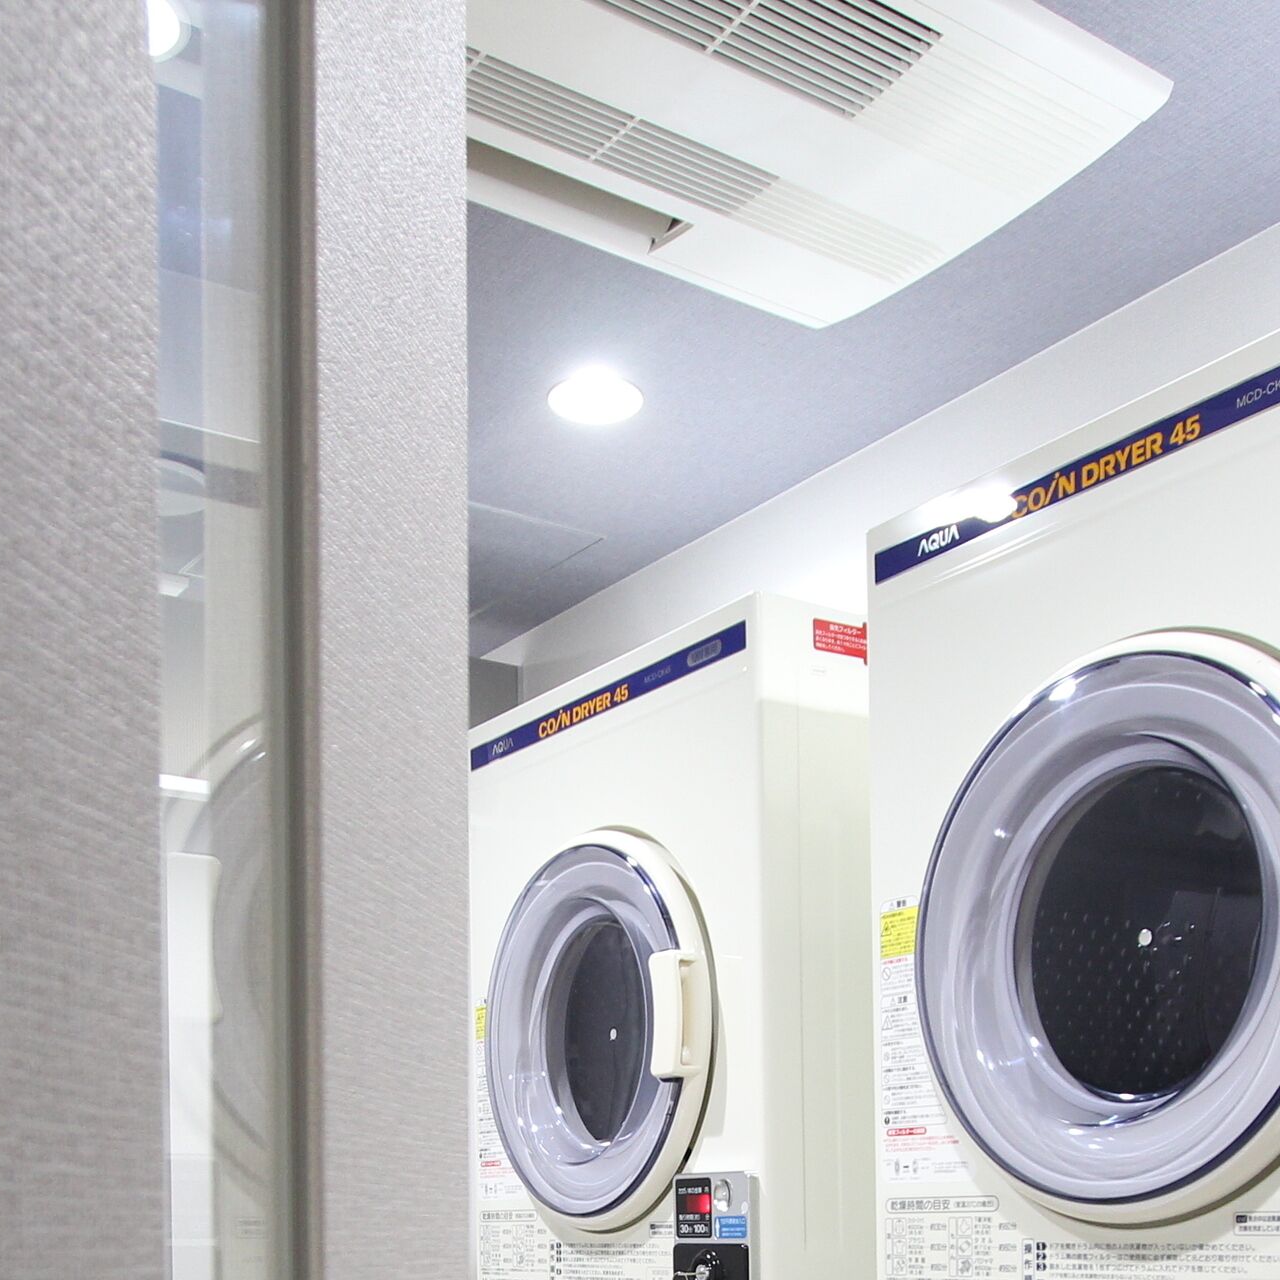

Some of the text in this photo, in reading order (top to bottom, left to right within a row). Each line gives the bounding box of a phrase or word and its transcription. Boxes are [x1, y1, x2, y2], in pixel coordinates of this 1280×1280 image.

[918, 524, 960, 556] AQUA
[1081, 431, 1164, 488] DRYER
[1169, 414, 1202, 446] 45
[492, 737, 514, 756] AQUA
[572, 692, 611, 724] DRYER
[613, 684, 629, 704] 45
[890, 1199, 951, 1210] 乾燥時間の目安
